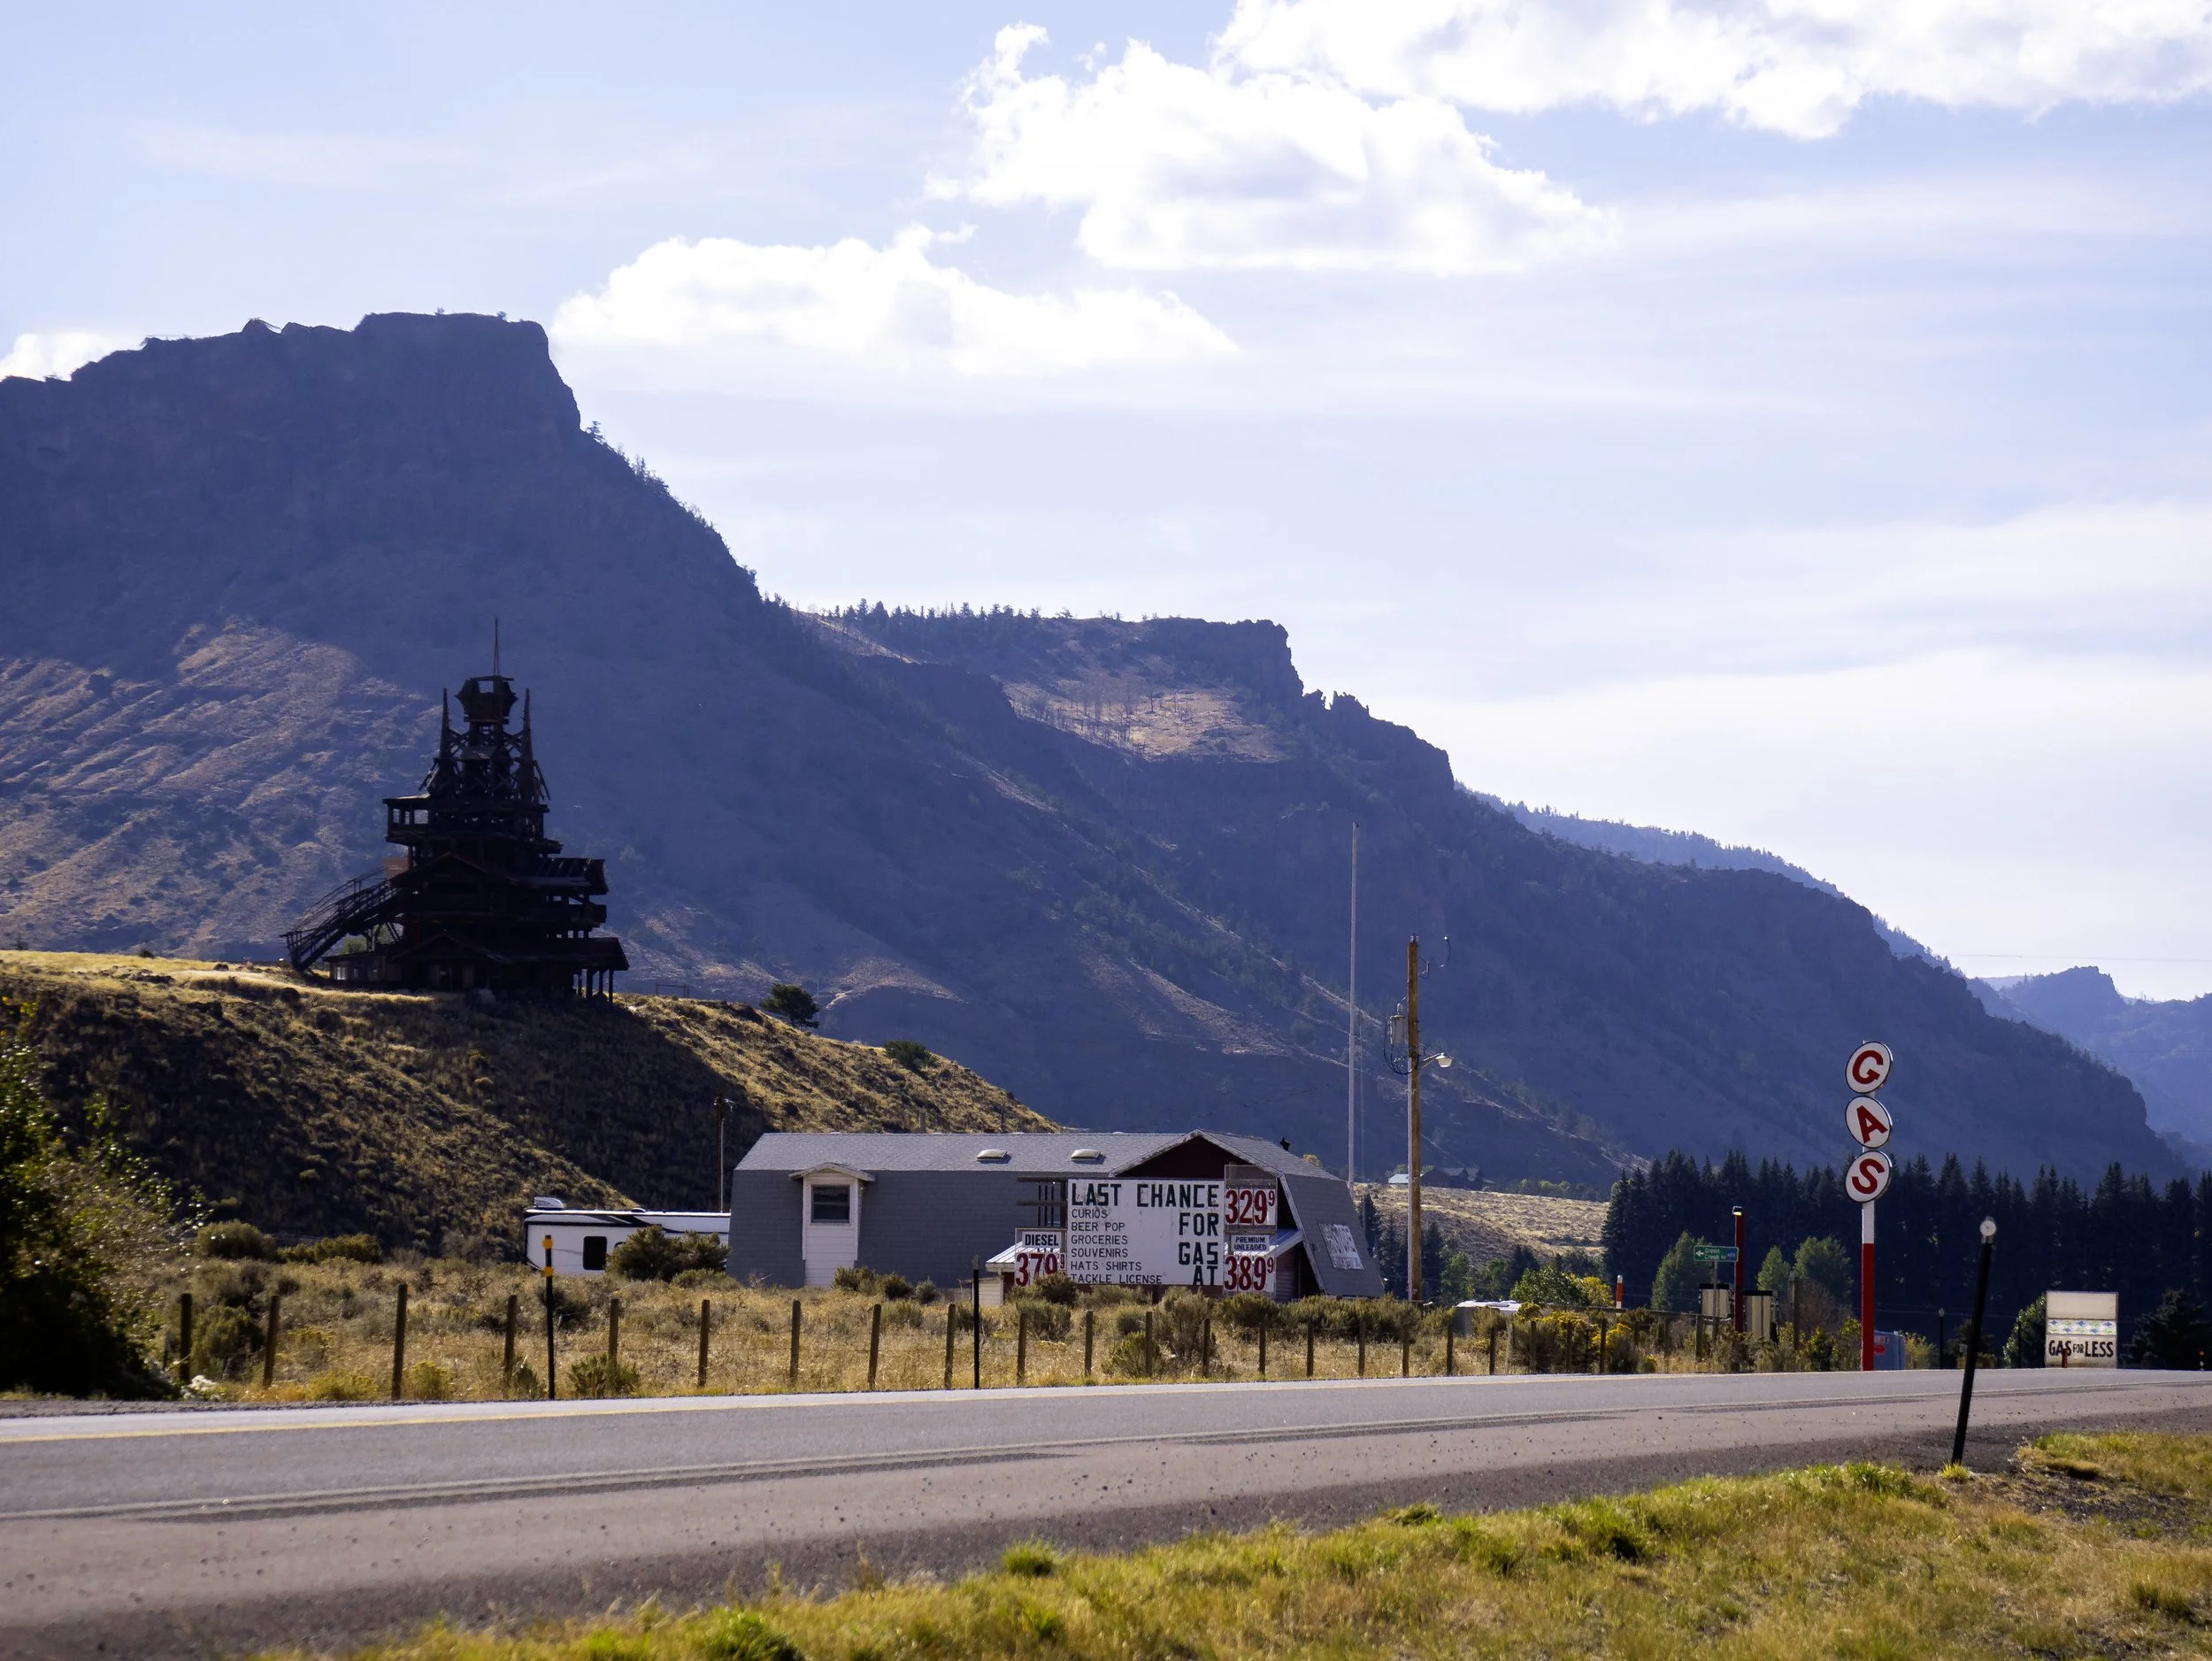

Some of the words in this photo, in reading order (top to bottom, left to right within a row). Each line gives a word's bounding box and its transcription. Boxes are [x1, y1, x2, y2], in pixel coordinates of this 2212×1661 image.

[1852, 1050, 1888, 1195] GAS
[1071, 1182, 1121, 1206] LAST
[1137, 1184, 1219, 1208] CHANCE
[1071, 1209, 1107, 1219] CURIOS
[1071, 1222, 1097, 1232] BEER
[1105, 1222, 1125, 1232] POP
[1179, 1212, 1219, 1236] FOR
[1025, 1234, 1059, 1246] DIESEL
[1071, 1234, 1128, 1245] GROCERIES
[1071, 1248, 1128, 1257] SOUVENIRS
[1179, 1242, 1218, 1265] GAS
[1071, 1261, 1099, 1271] HATS
[1105, 1261, 1142, 1271] SHIRTS
[1071, 1273, 1112, 1284] TACKLE
[1119, 1274, 1163, 1285] LICENSE
[1193, 1265, 1218, 1286] AT
[2048, 1340, 2072, 1357] GAS
[2072, 1343, 2084, 1353] FOR
[2085, 1341, 2114, 1358] LESS
